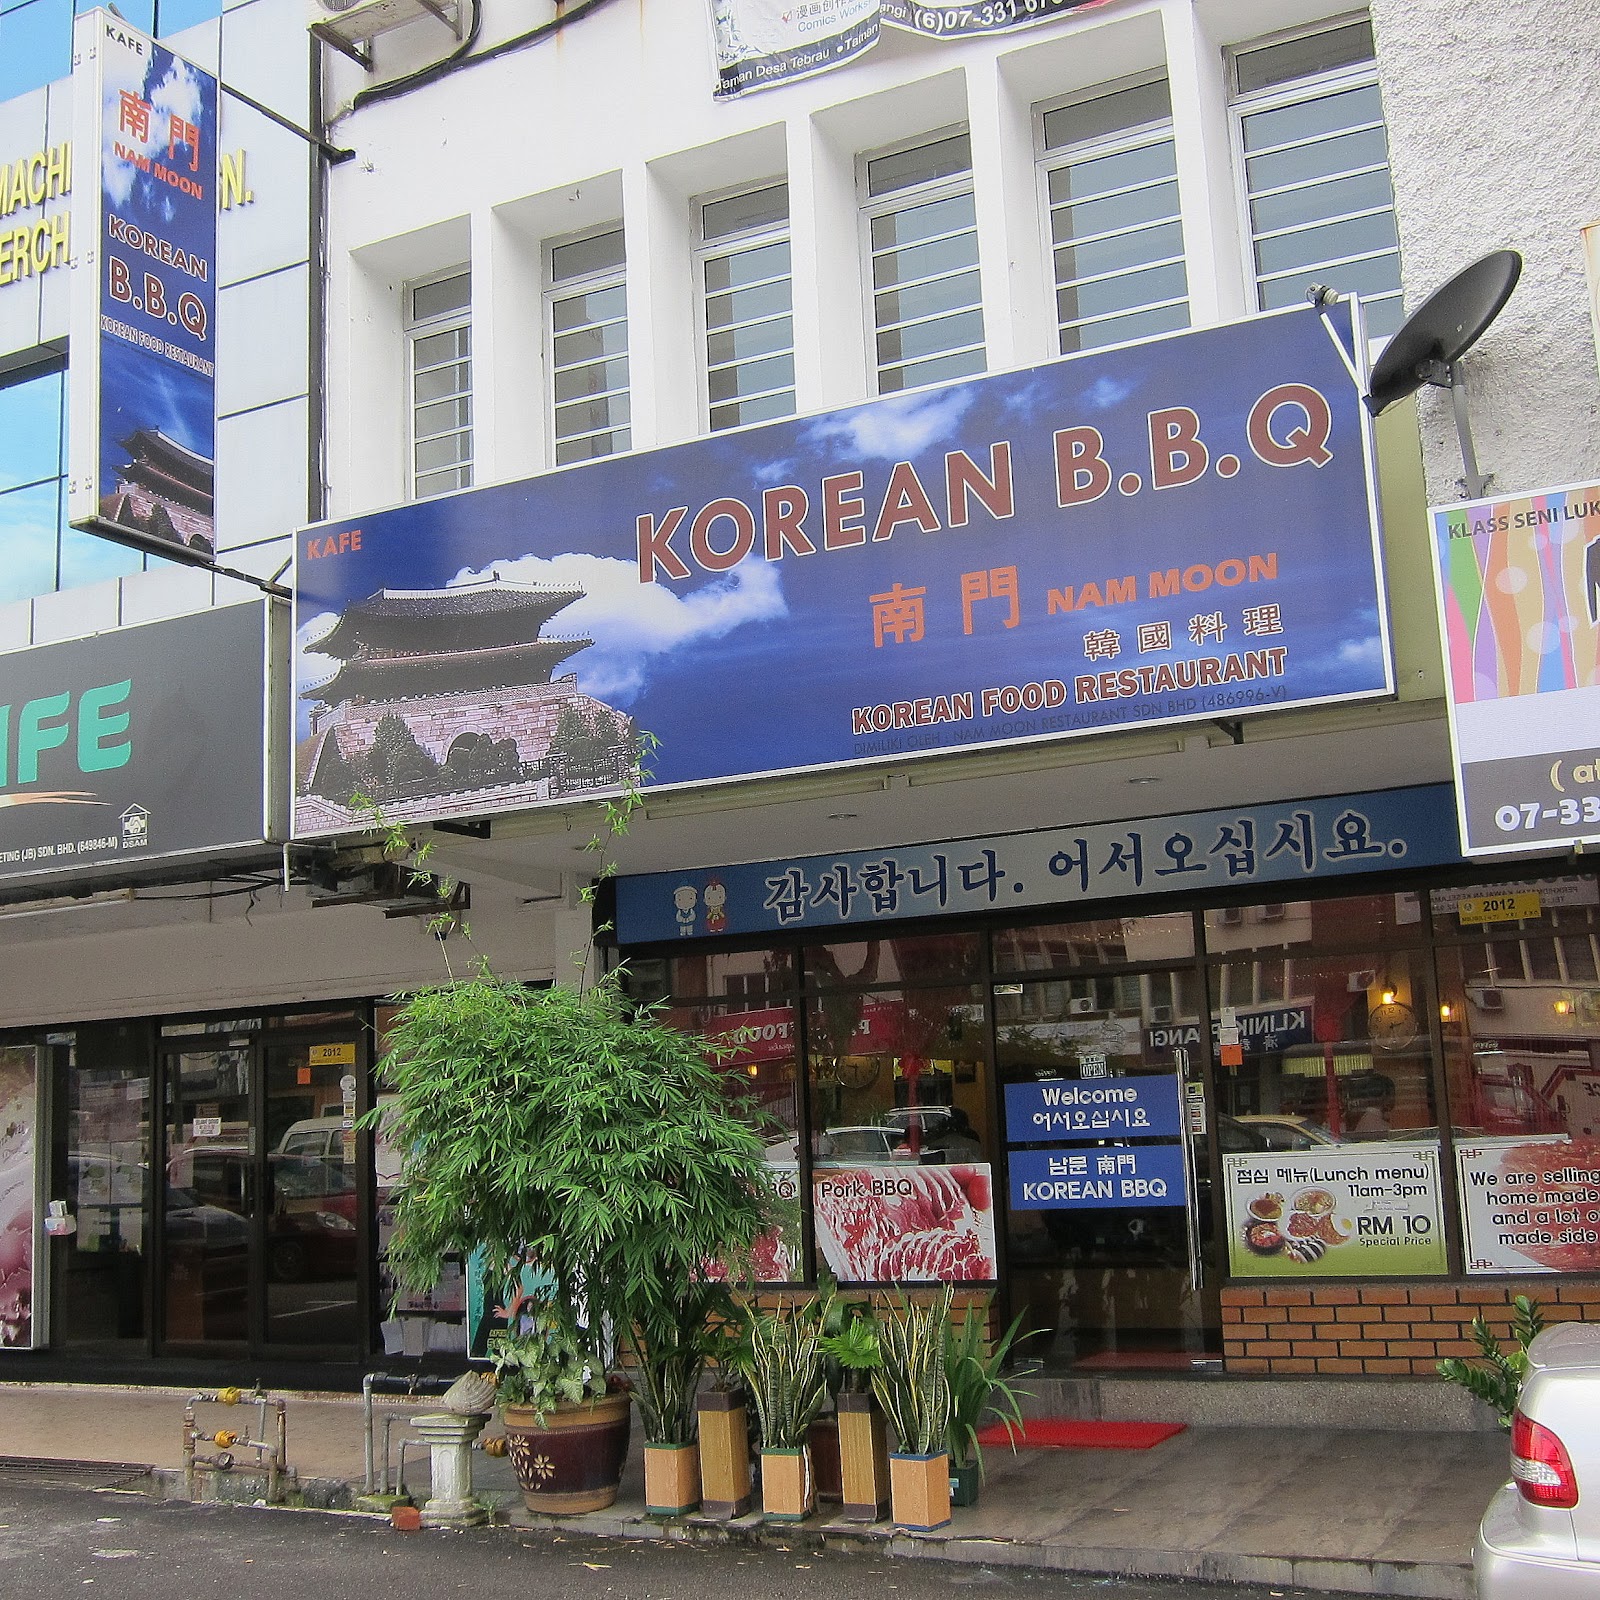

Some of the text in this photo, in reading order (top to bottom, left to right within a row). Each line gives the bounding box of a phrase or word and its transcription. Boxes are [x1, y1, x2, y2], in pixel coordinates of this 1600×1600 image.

[797, 14, 836, 32] Comics
[105, 24, 143, 56] KAFE
[755, 61, 787, 77] Desa
[790, 48, 830, 69] Tebrau
[114, 140, 203, 200] NAM MOON
[108, 213, 208, 283] KOREAN
[108, 255, 208, 341] B.B.Q
[101, 314, 214, 377] KOREAN FOOD RESTAURANT
[634, 382, 1334, 584] KOREAN B.B.Q
[1448, 514, 1509, 540] KLASS
[1513, 507, 1559, 528] SENI
[307, 530, 362, 560] KAFE
[1047, 553, 1278, 614] NAM MOON
[1083, 603, 1285, 660] 韓國料理
[852, 646, 1288, 736] KOREAN FOOD RESTAURANT
[907, 731, 940, 749] OLEH
[953, 726, 985, 743] NAM
[989, 720, 1036, 739] MOON
[1041, 707, 1128, 730] RESTAURANT
[1133, 702, 1163, 718] SDN
[1168, 698, 1197, 714] BHD
[1202, 684, 1287, 712] (486996-V)
[57, 842, 76, 855] BHD.
[122, 838, 148, 849] DSAM
[763, 809, 1408, 926] 감사합니다. 어서오십시요.
[1483, 899, 1515, 912] 2012
[323, 1047, 342, 1057] 2012
[1082, 1062, 1105, 1077] OPEN
[1042, 1087, 1138, 1106] Welcome
[1032, 1107, 1150, 1132] 어서오십시요
[1049, 1154, 1136, 1176] 남문 南門
[1236, 1168, 1269, 1184] 점심
[1375, 1163, 1429, 1181] menu)
[1469, 1167, 1600, 1186] We are selling
[821, 1179, 913, 1198] Pork BBQ
[1023, 1178, 1167, 1201] KOREAN BBQ
[1347, 1183, 1428, 1198] 11am-3pm
[1486, 1187, 1598, 1205] home made
[1357, 1214, 1431, 1235] RM 10
[1492, 1208, 1600, 1225] and a lot o
[1360, 1236, 1431, 1248] Special Price
[1499, 1227, 1597, 1245] made side
